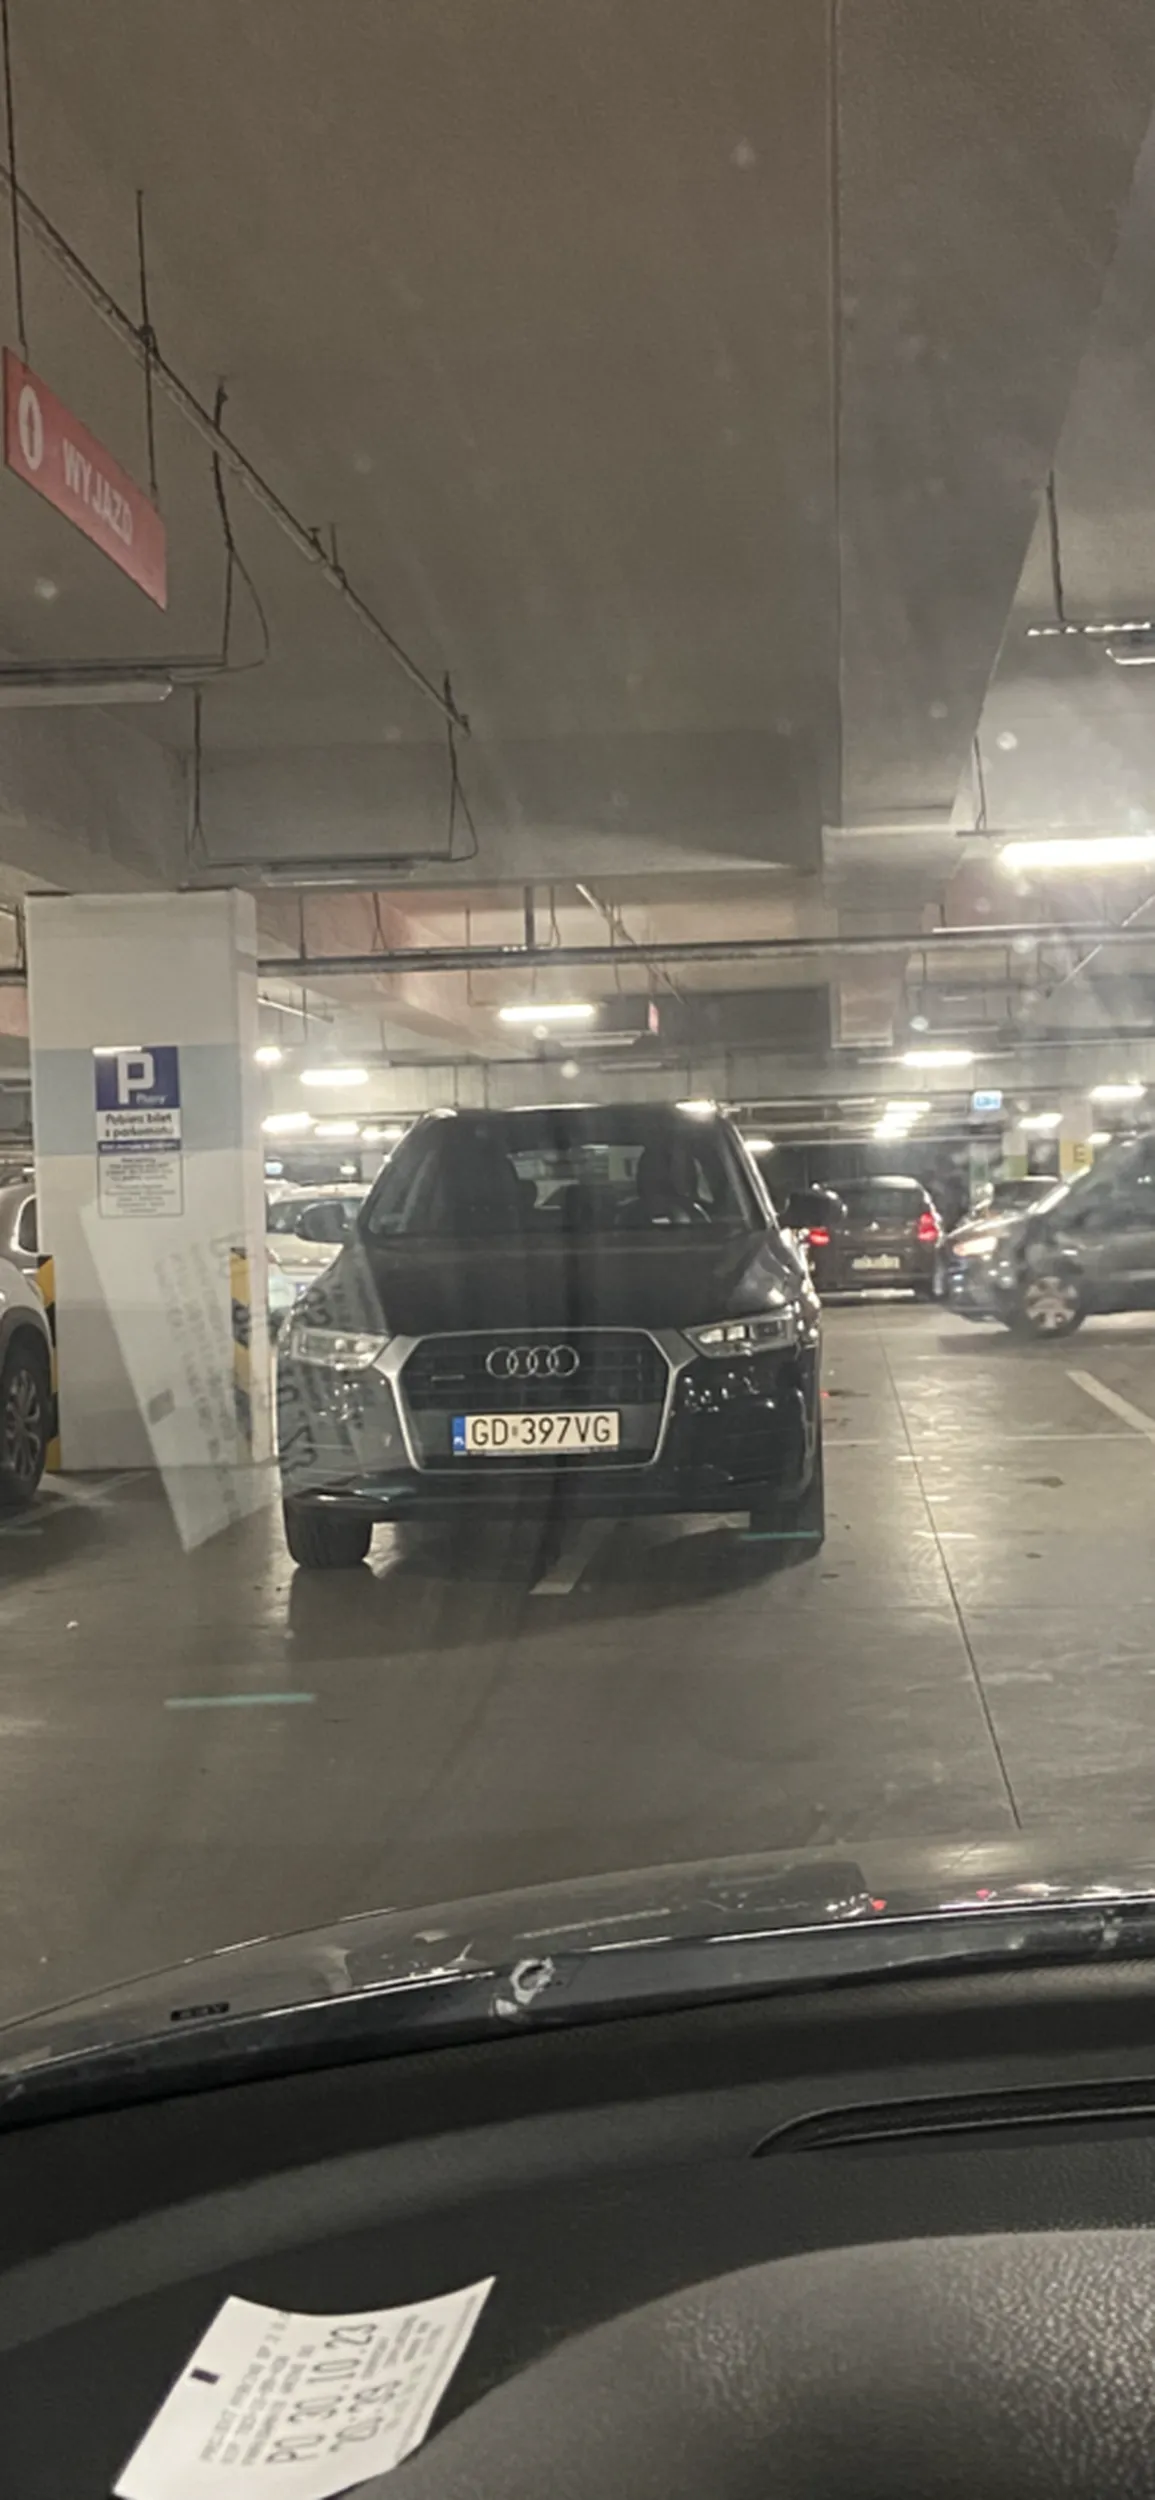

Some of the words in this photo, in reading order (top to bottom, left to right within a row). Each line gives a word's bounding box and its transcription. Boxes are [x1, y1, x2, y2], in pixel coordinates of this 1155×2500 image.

[62, 437, 133, 546] WYJAZD
[116, 1052, 156, 1105] P
[471, 1418, 509, 1446] GD
[520, 1415, 611, 1445] 397VG
